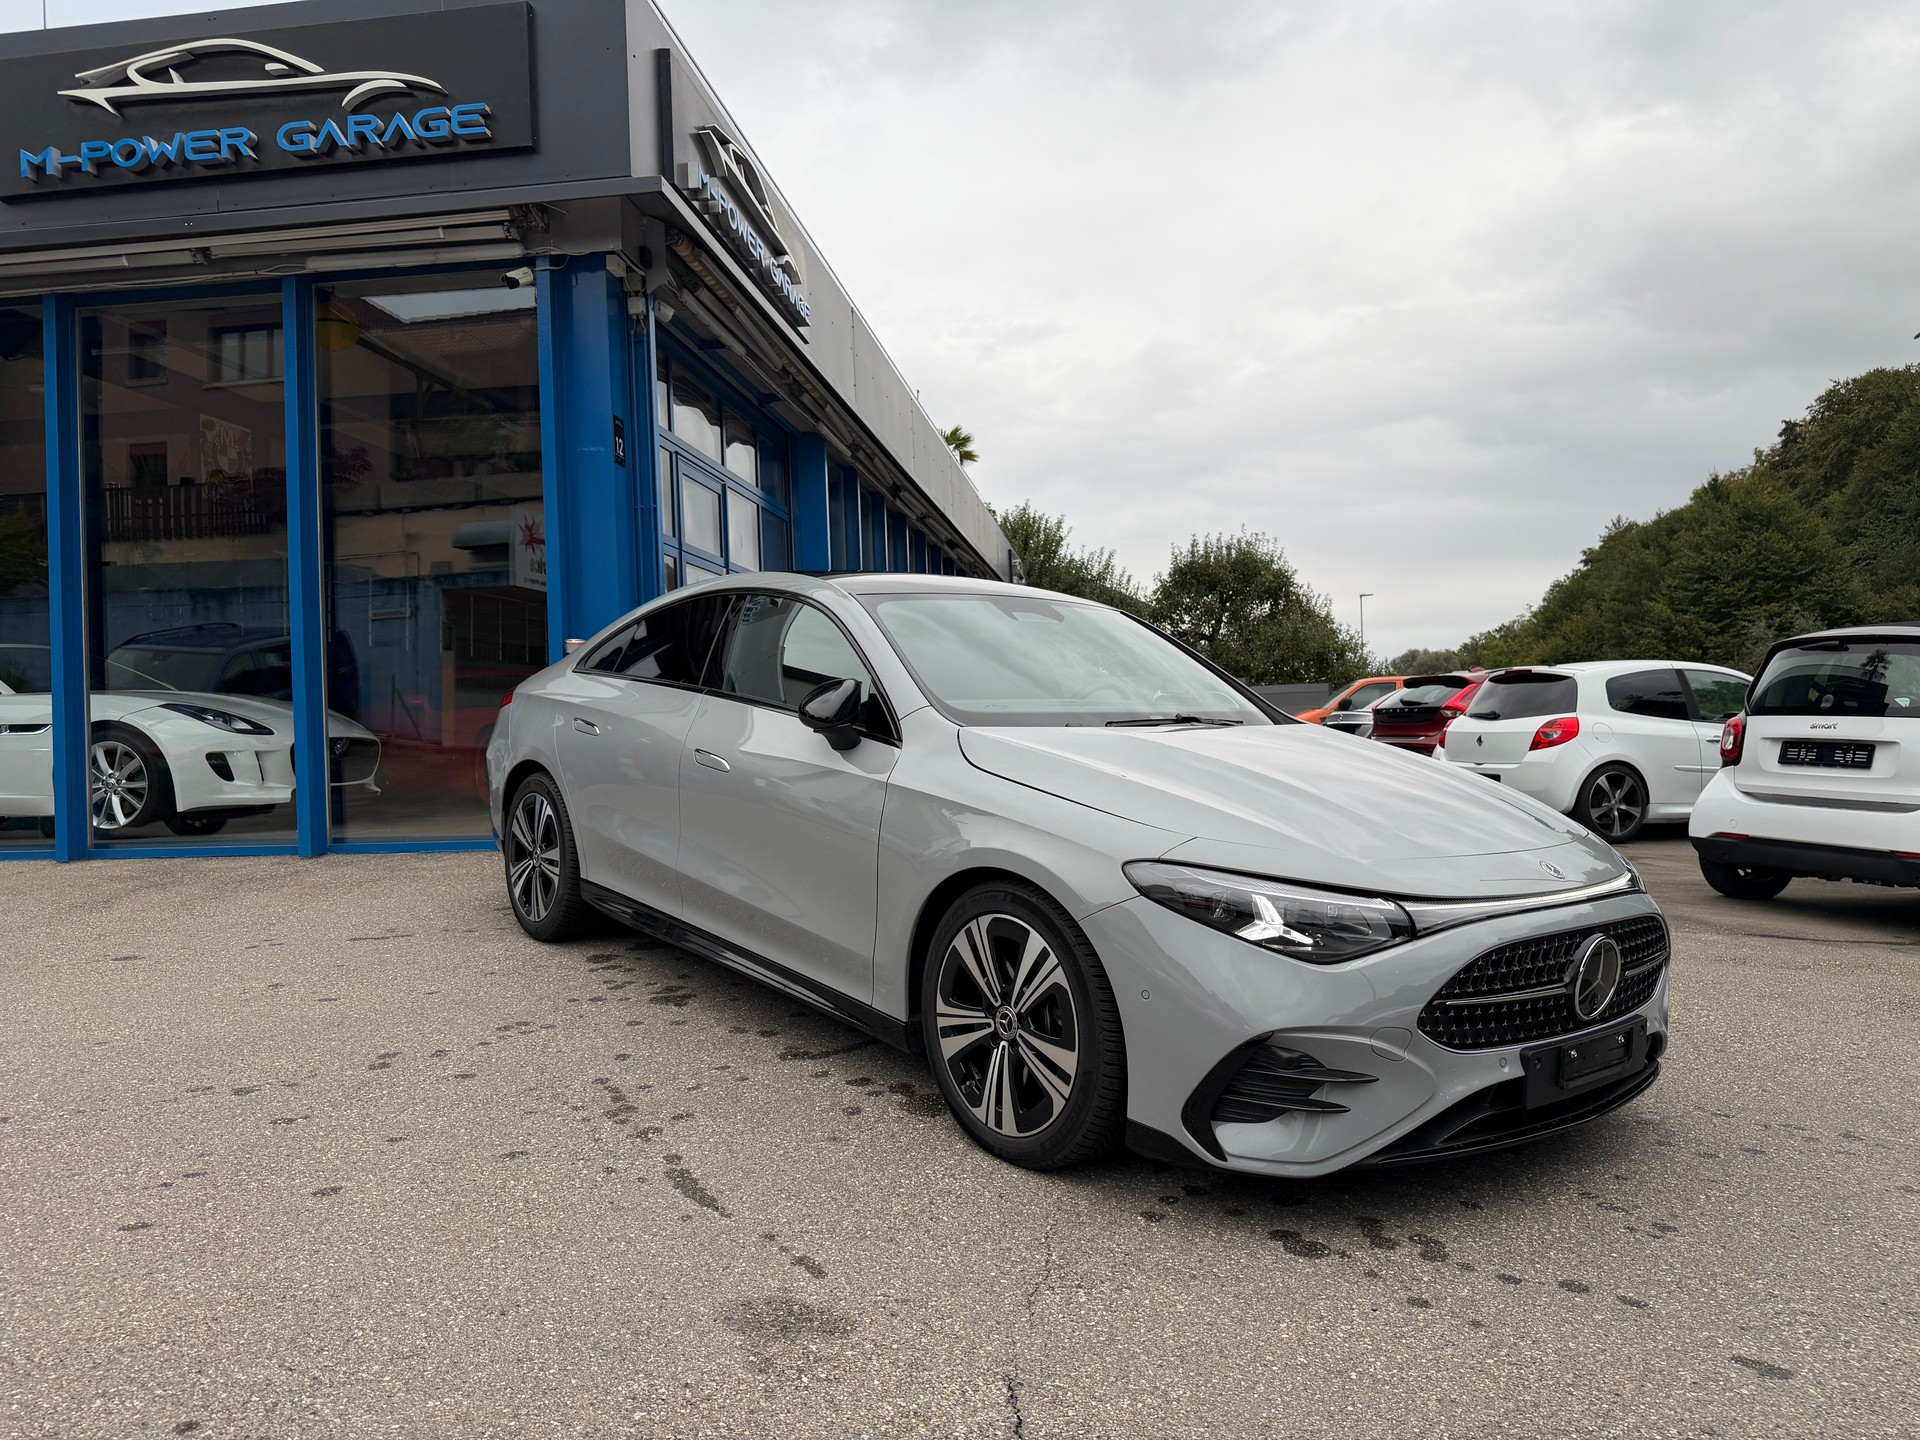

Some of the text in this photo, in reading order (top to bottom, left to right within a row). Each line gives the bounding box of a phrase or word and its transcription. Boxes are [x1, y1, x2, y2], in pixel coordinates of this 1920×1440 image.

[20, 102, 489, 178] M-POWER GARAGE
[698, 162, 812, 321] M-POWER GARAGE
[615, 436, 624, 456] 12
[1809, 722, 1839, 730] smart
